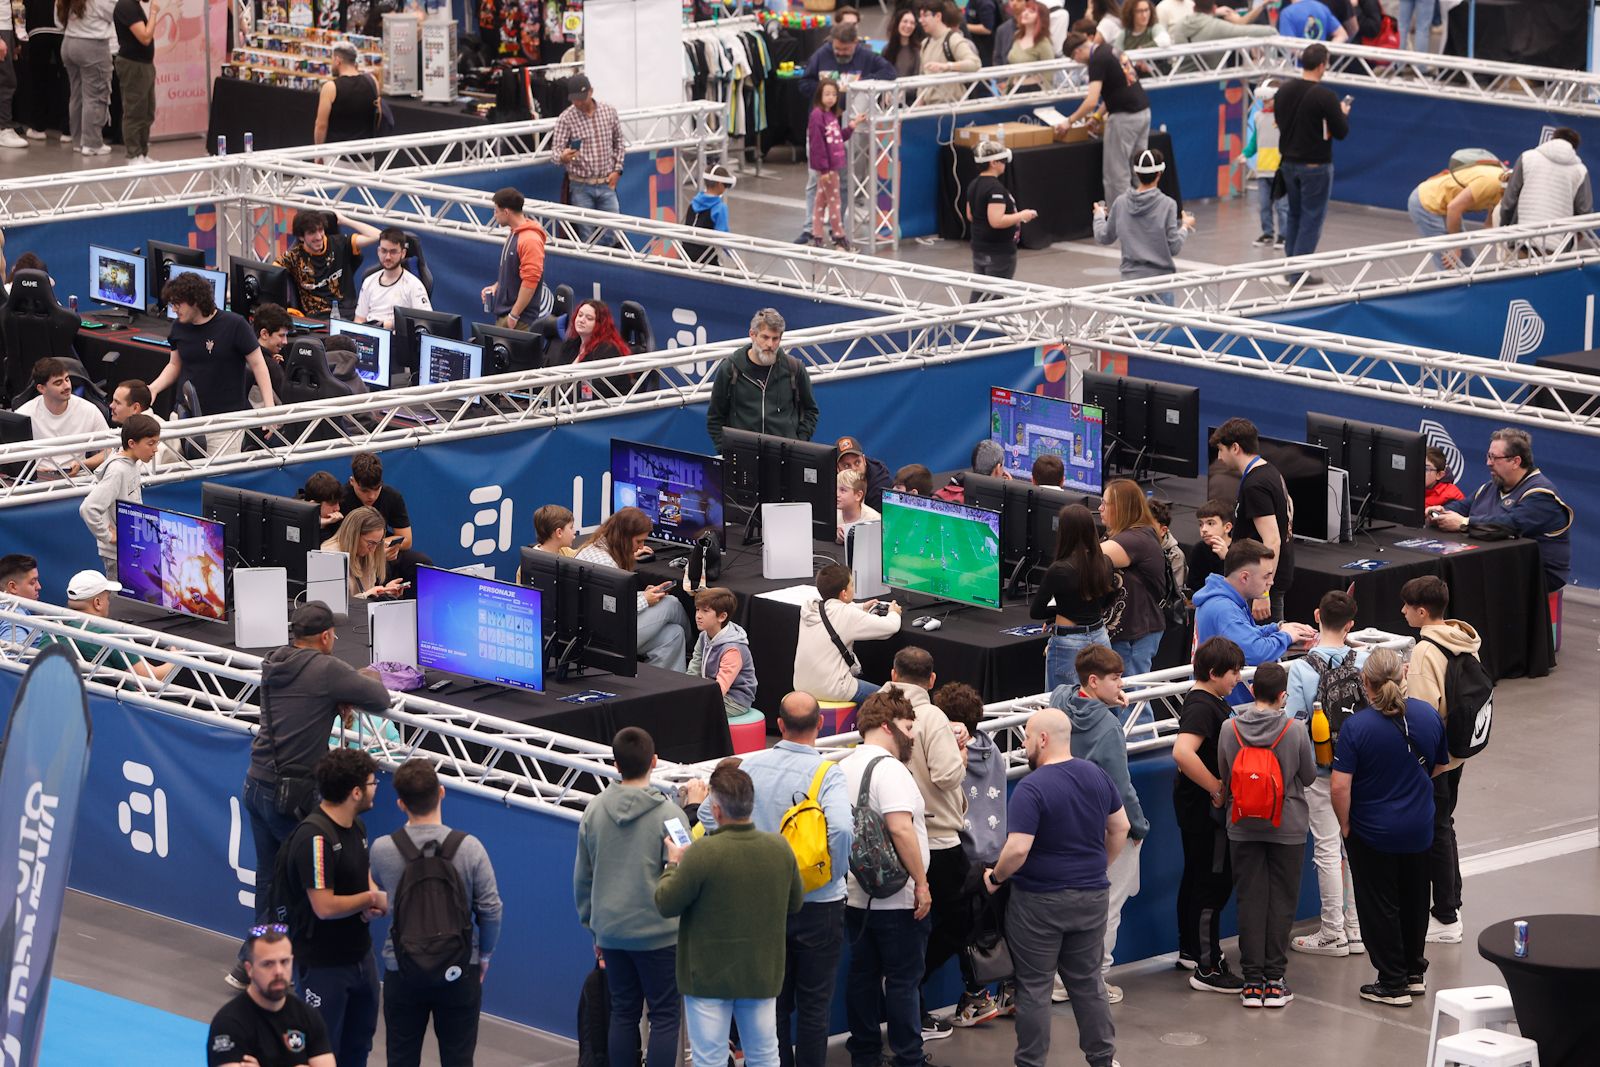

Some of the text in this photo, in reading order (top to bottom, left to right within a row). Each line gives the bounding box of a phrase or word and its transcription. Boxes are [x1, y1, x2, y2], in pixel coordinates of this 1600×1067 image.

[21, 280, 38, 288] GAME
[298, 348, 313, 357] GAME
[479, 584, 516, 598] PERSONAJE
